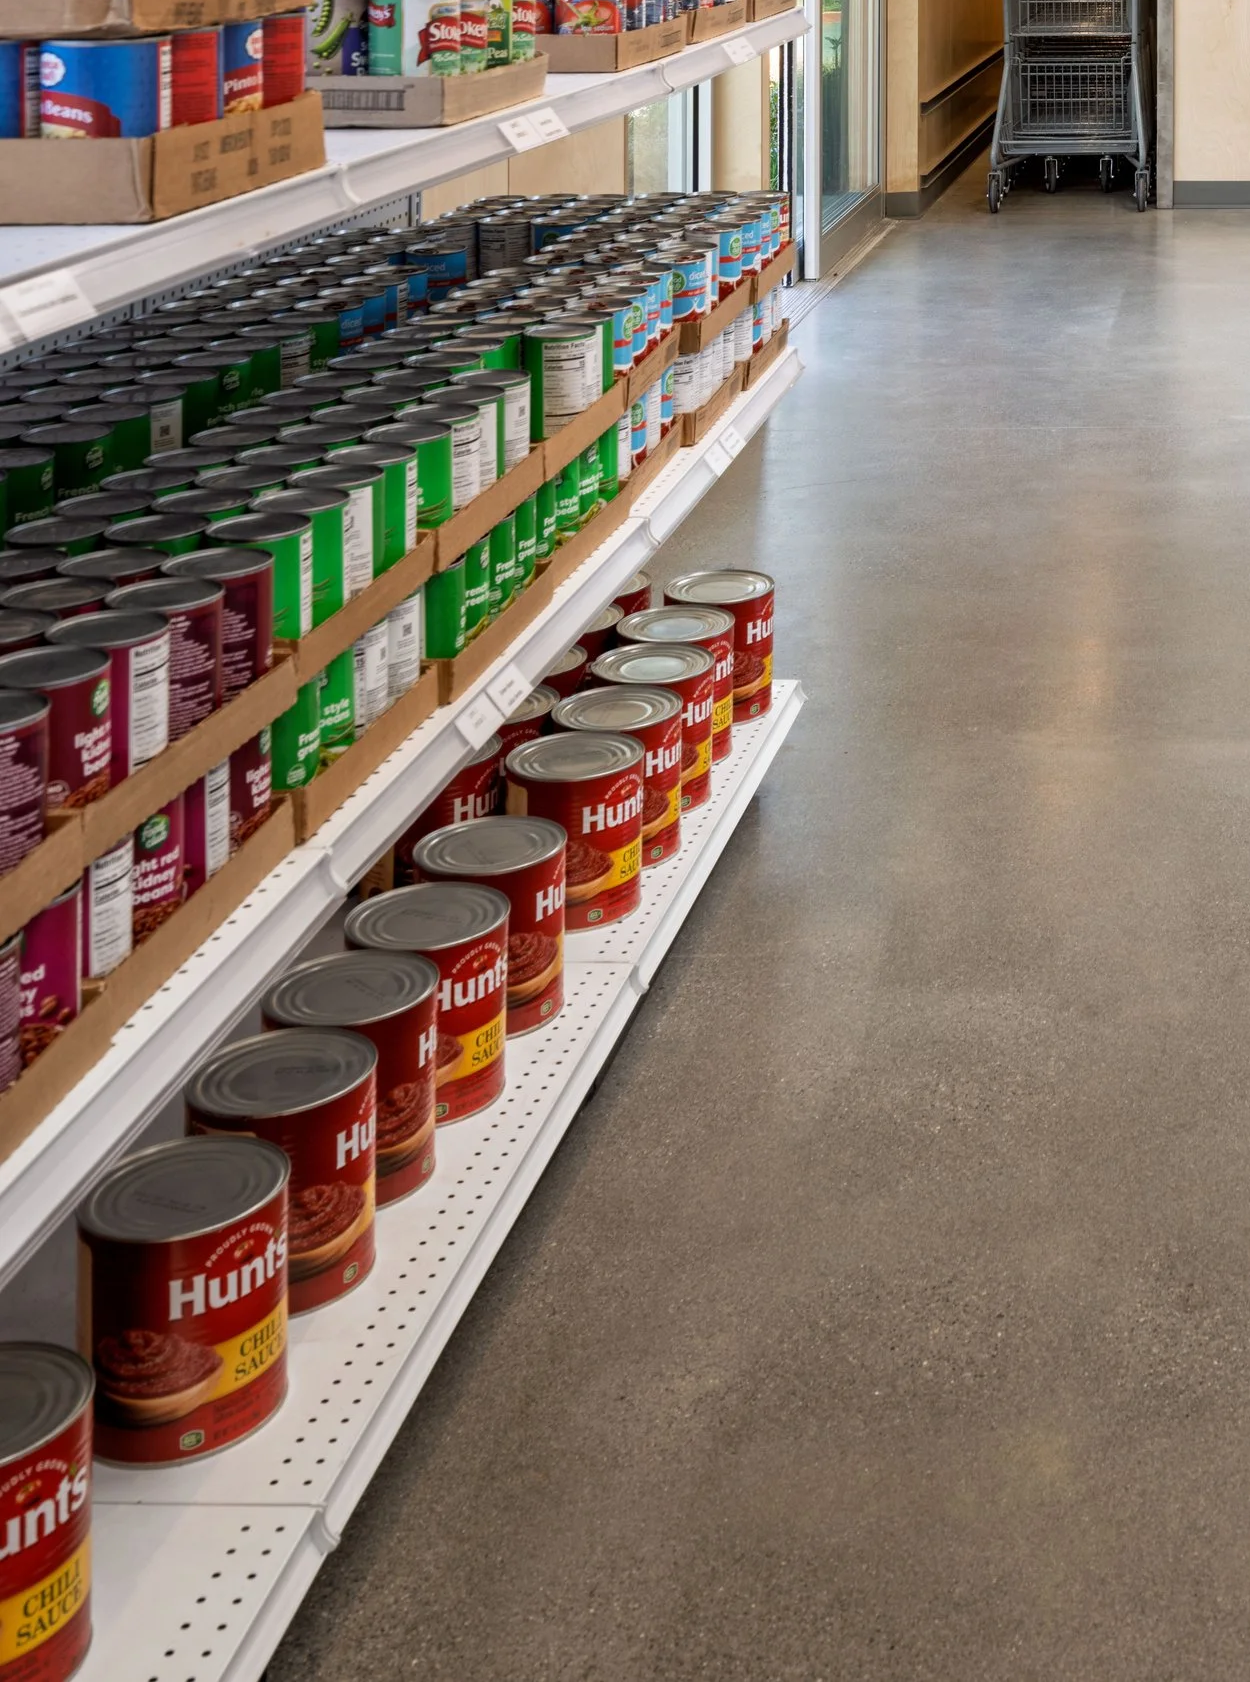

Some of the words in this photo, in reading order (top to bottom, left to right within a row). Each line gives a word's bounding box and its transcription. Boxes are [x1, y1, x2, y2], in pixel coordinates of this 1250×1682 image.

[160, 843, 181, 867] red
[451, 943, 484, 975] PROUDLY
[204, 1227, 248, 1269] PROUDLY
[249, 1221, 274, 1236] GROWN
[239, 1310, 283, 1358] CHILI
[23, 1557, 82, 1619] CHILI
[15, 1580, 83, 1648] SAUCE
